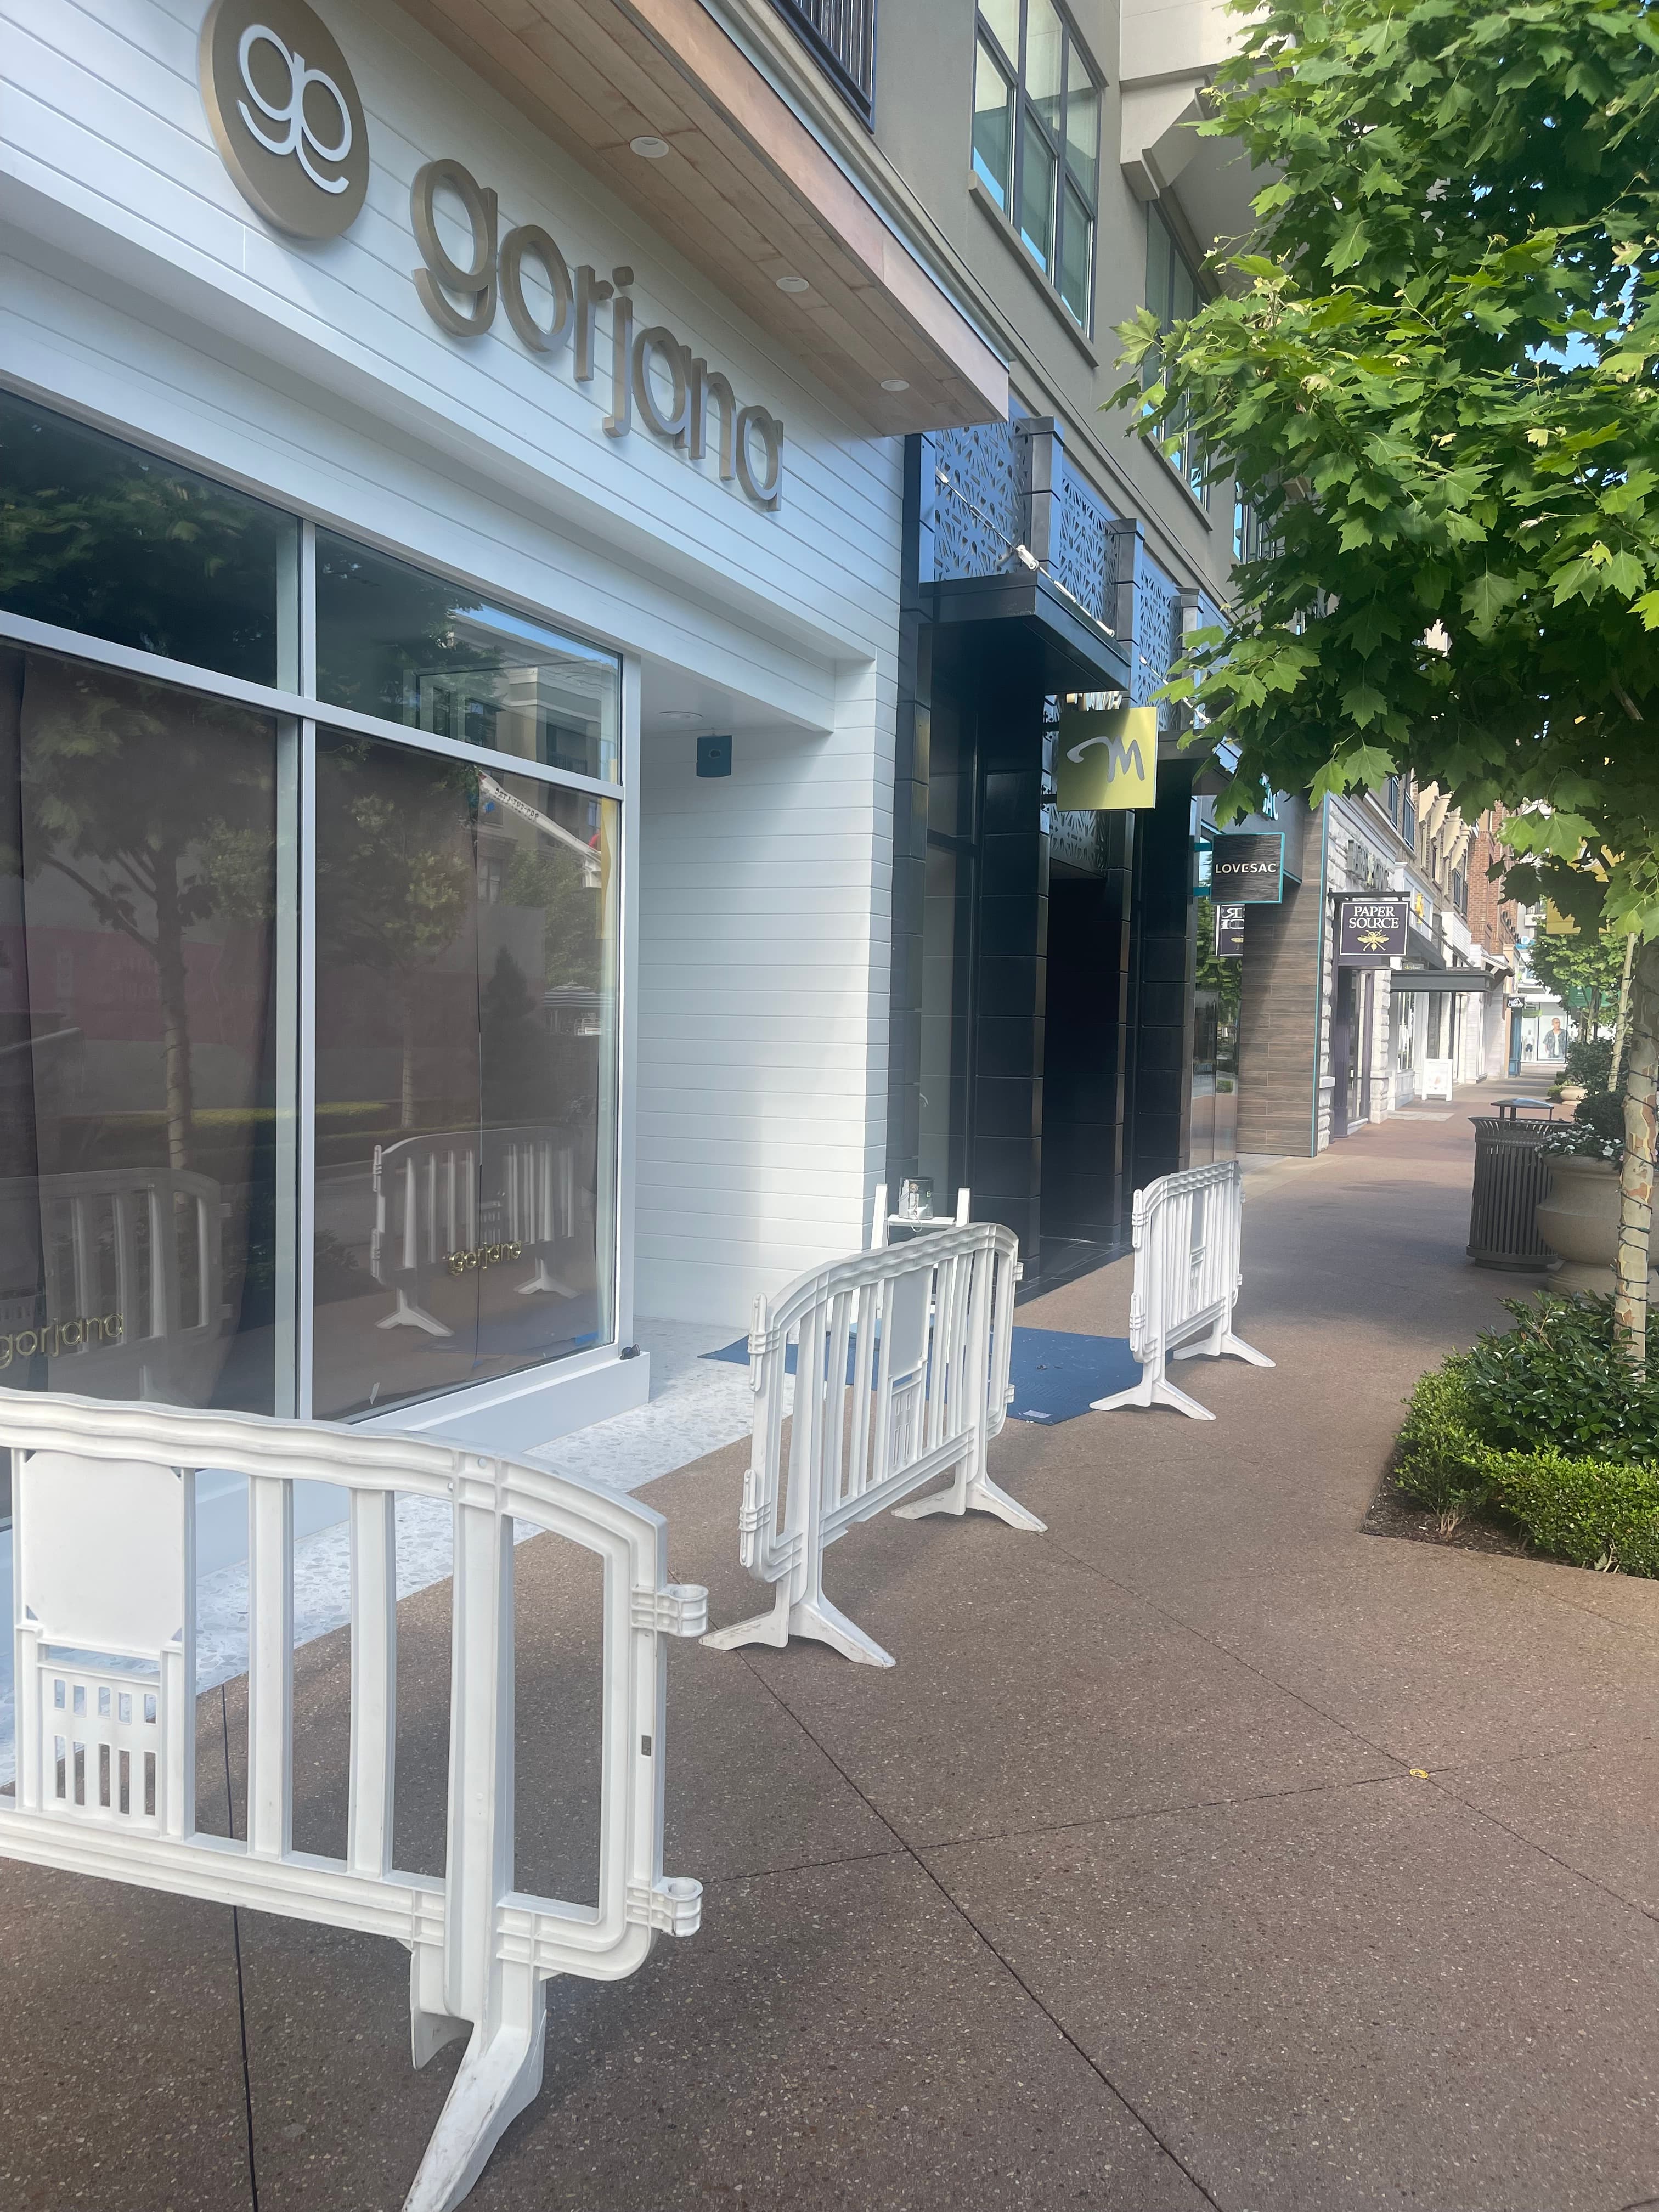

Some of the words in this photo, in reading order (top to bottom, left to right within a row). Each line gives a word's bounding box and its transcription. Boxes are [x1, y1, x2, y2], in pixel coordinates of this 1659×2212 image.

[410, 159, 785, 511] gorjana
[1215, 863, 1277, 873] LOVESAC
[1353, 906, 1395, 917] PAPER
[1348, 917, 1400, 928] SOURCE
[449, 1240, 522, 1276] gorjana
